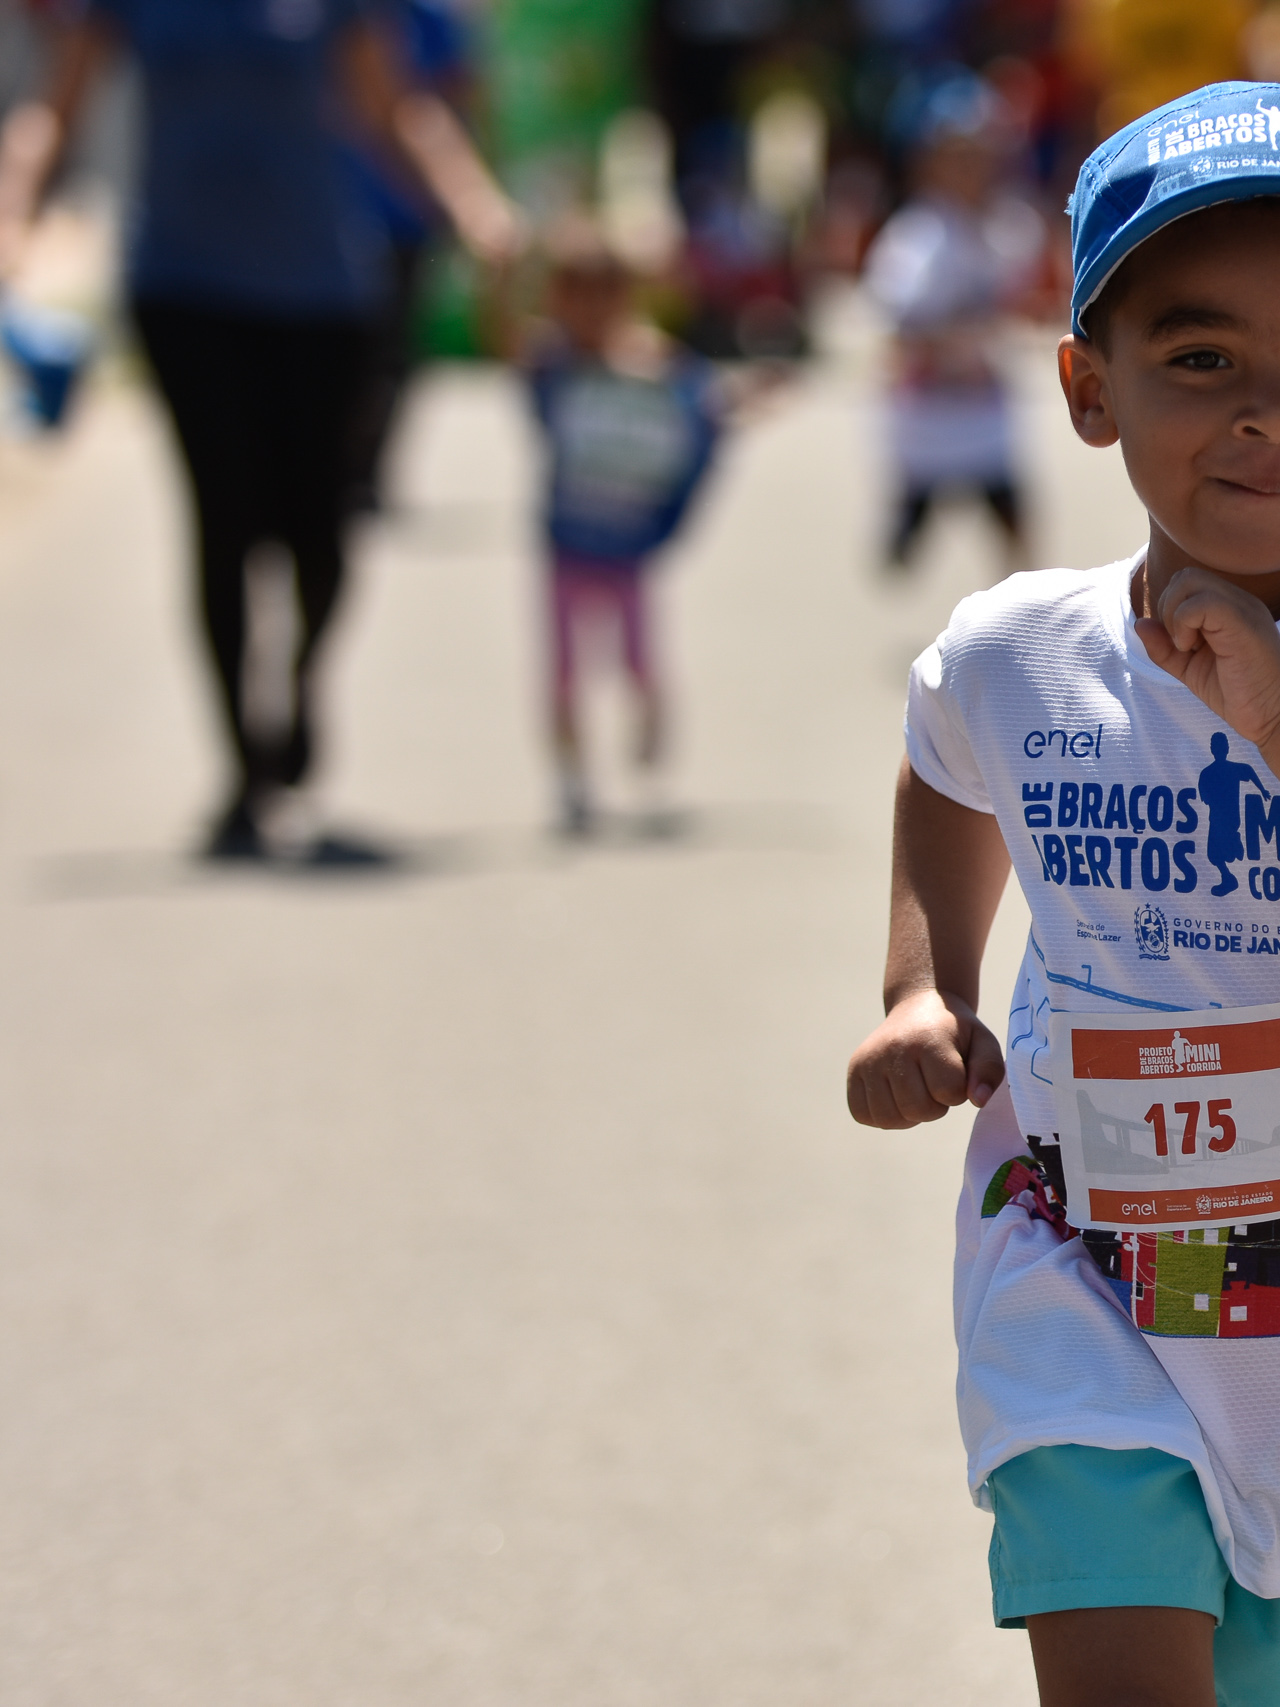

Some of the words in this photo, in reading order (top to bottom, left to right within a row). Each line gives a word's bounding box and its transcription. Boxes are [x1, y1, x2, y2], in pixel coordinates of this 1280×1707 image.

[1147, 110, 1200, 137] enel
[1164, 128, 1184, 146] DE
[1164, 127, 1267, 160] ABERTOS
[1217, 159, 1238, 169] RIO
[1241, 158, 1259, 167] DE
[1024, 724, 1103, 758] enel
[1022, 782, 1053, 828] DE
[1058, 782, 1198, 834] BRAÇOS
[1173, 917, 1243, 932] GOVERNO
[1252, 924, 1269, 934] DO
[1098, 933, 1121, 942] Lazer
[1173, 930, 1210, 950] RIO
[1215, 934, 1242, 952] DE
[1139, 1046, 1173, 1056] PROJETO
[1184, 1043, 1220, 1063] MINI
[1140, 1064, 1174, 1075] ABERTOS
[1186, 1061, 1222, 1073] CORRIDA
[1144, 1098, 1237, 1157] 175
[1121, 1200, 1157, 1216] enel
[1213, 1201, 1227, 1209] RIO
[1240, 1196, 1273, 1206] JANEIRO
